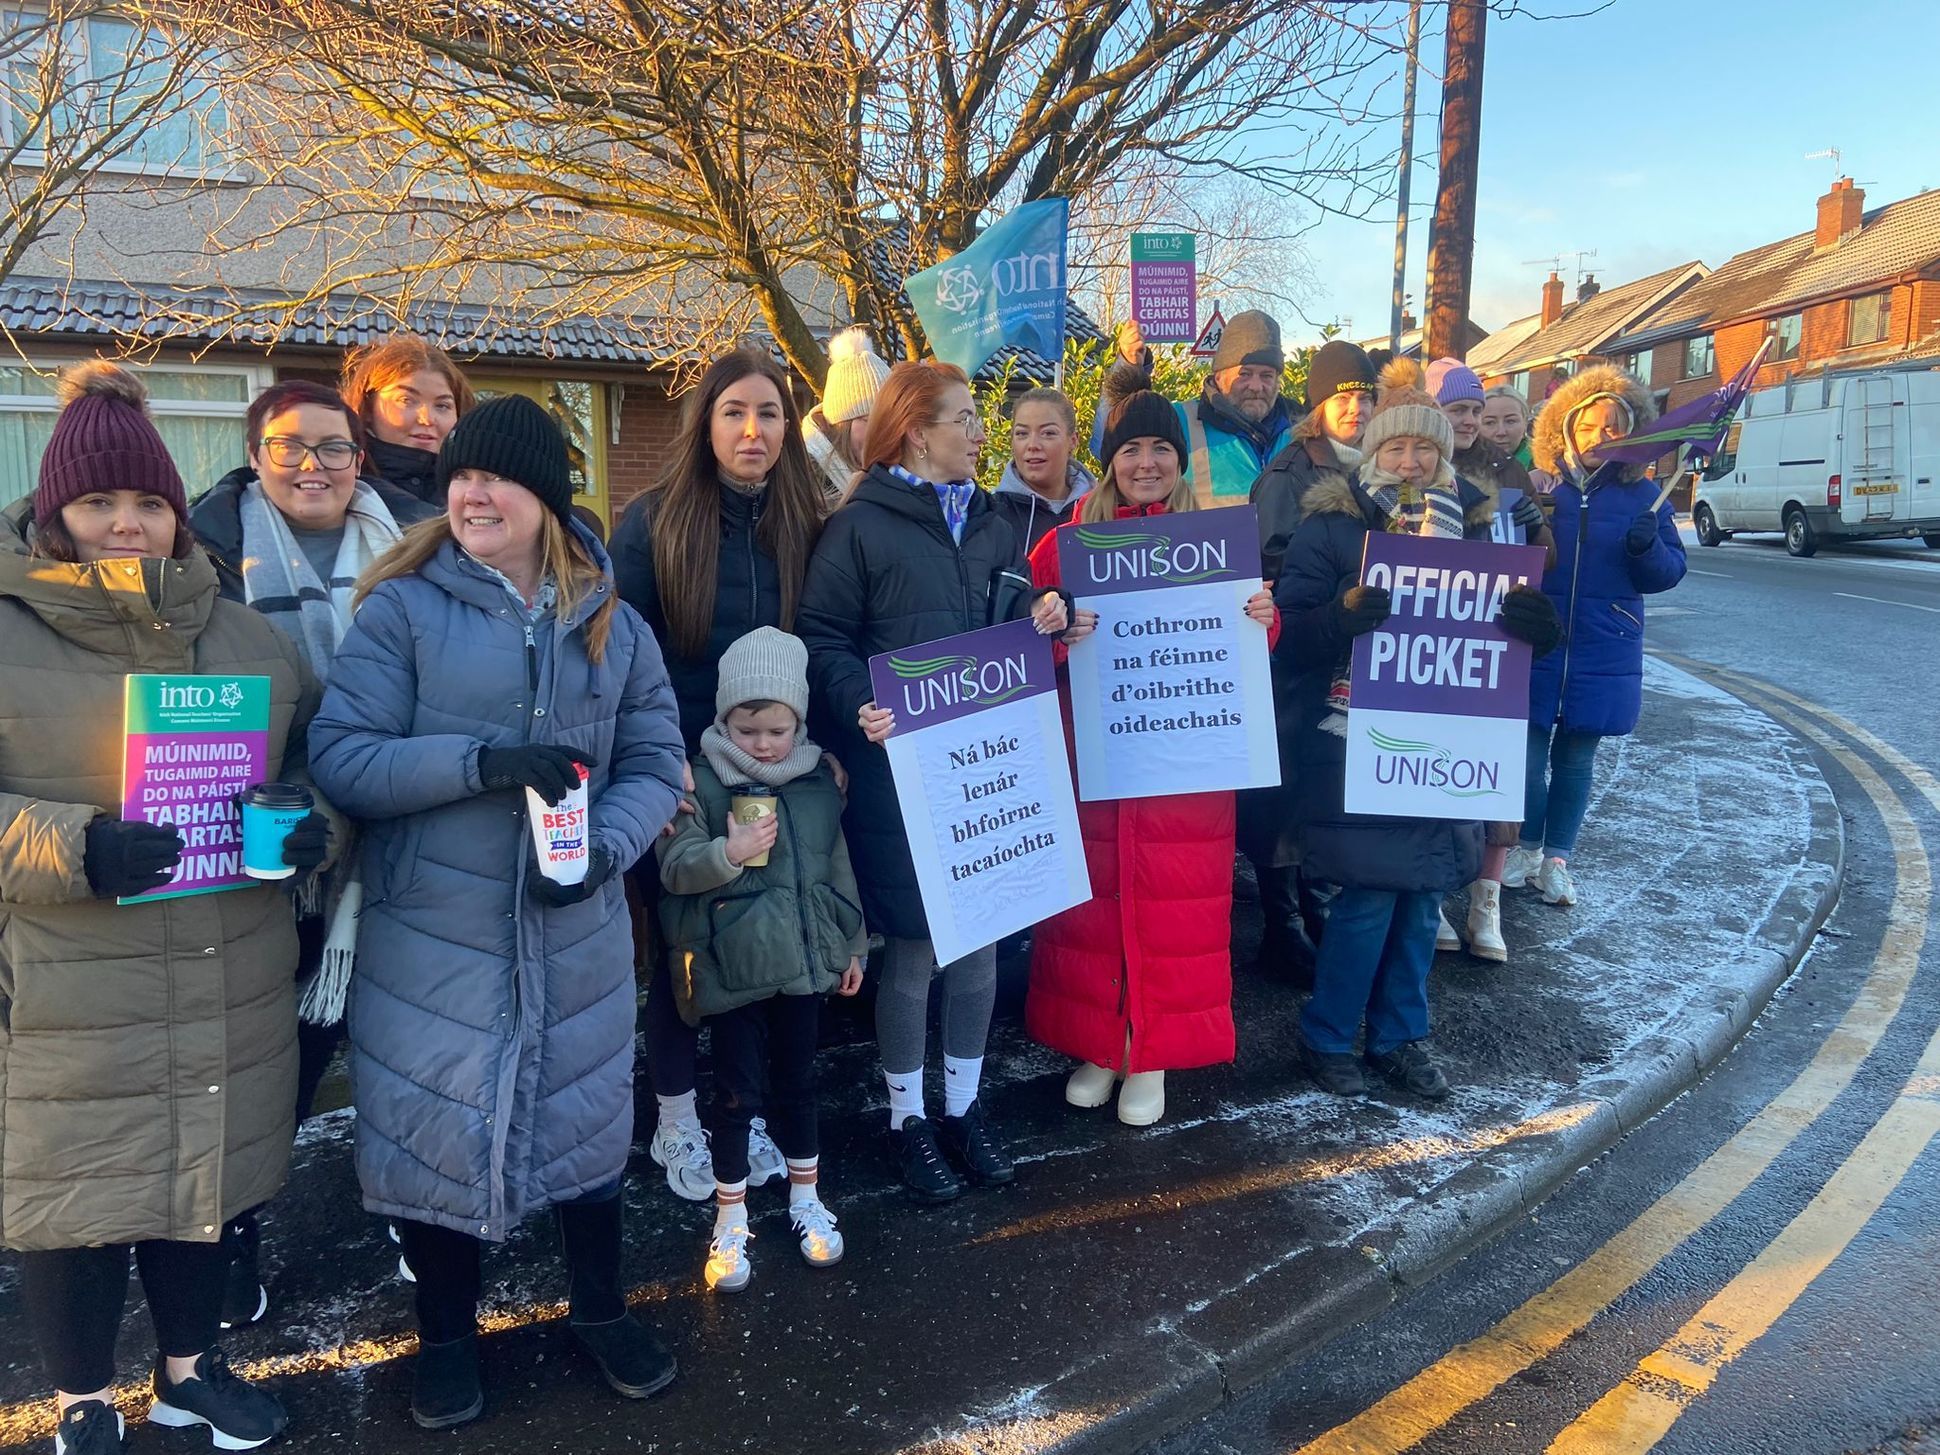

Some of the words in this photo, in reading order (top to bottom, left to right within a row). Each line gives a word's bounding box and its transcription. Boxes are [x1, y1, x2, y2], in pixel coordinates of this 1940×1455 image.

[1143, 235, 1169, 249] into
[1138, 265, 1189, 277] MÚINIMID,
[1139, 287, 1150, 295] DO
[1151, 287, 1162, 295] NA
[1139, 297, 1189, 308] TABHAIR
[1139, 308, 1190, 320] CEARTAS
[1141, 320, 1190, 336] DÚINN!
[1089, 538, 1227, 583] UNISON
[1113, 615, 1223, 638] Cothrom
[1113, 655, 1143, 671] na
[1150, 647, 1228, 667] féinne
[1369, 631, 1508, 689] PICKET
[159, 682, 215, 709] into
[904, 653, 1028, 716] UNISON
[1111, 677, 1235, 703] d’oibrithe
[1109, 708, 1242, 735] oideachais
[145, 741, 252, 764] MÚINIMID,
[948, 744, 980, 770] Ná
[983, 734, 1020, 761] bác
[144, 766, 218, 782] TUGAIMID
[220, 764, 251, 778] AIRE
[1375, 754, 1499, 790] UNISON
[143, 787, 169, 802] DO
[172, 784, 195, 800] NA
[962, 771, 1019, 802] lenár
[543, 808, 585, 828] BEST
[951, 801, 1042, 844] bhfoirne
[548, 847, 586, 862] WORLD
[951, 830, 1056, 882] tacaíochta
